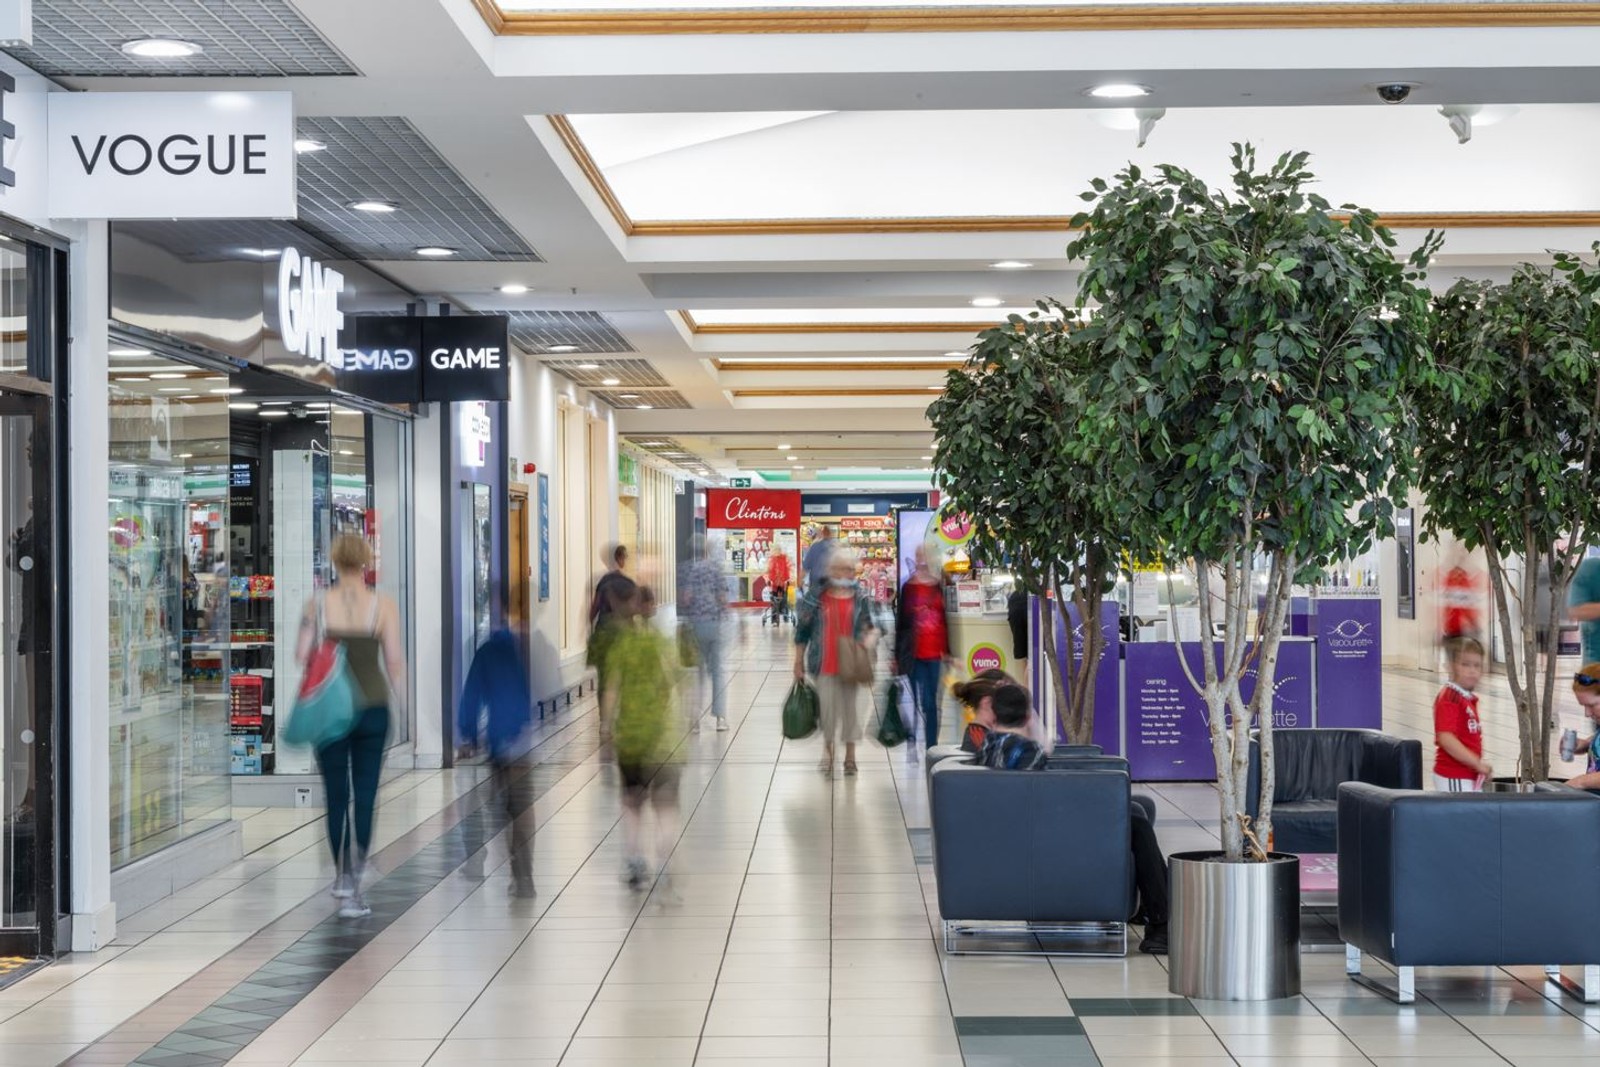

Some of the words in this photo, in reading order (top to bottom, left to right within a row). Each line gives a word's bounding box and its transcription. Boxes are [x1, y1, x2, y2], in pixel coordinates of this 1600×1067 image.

[71, 134, 266, 175] VOGUE
[279, 247, 344, 369] GAME
[430, 347, 500, 370] GAME
[725, 496, 786, 521] Clintons
